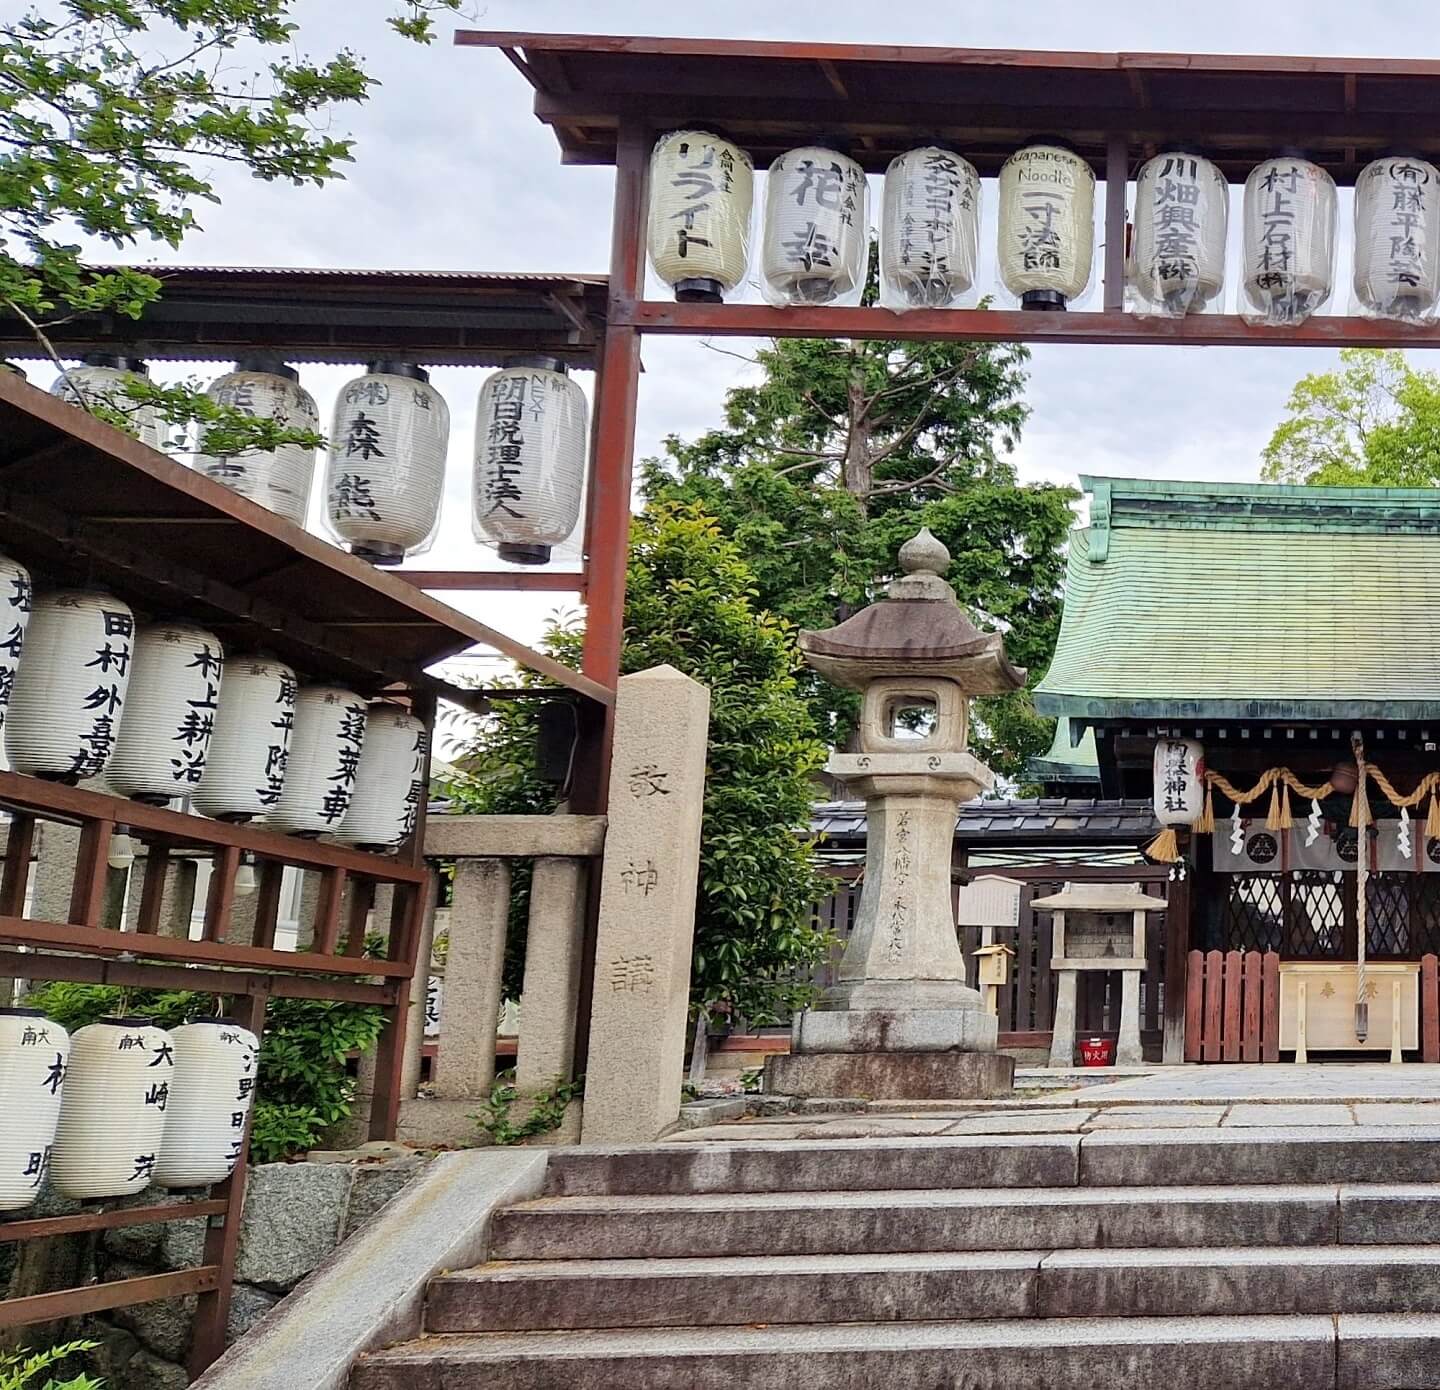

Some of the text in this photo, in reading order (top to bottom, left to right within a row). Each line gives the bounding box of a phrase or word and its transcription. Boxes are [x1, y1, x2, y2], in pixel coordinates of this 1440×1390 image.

[669, 142, 716, 258] リライト
[1018, 168, 1073, 188] Noodle
[1016, 191, 1066, 272] 一寸法師
[484, 375, 529, 519] 朝日税理士法人
[611, 763, 672, 994] 敬神講
[21, 1026, 52, 1047] 献
[117, 1033, 147, 1051] 献
